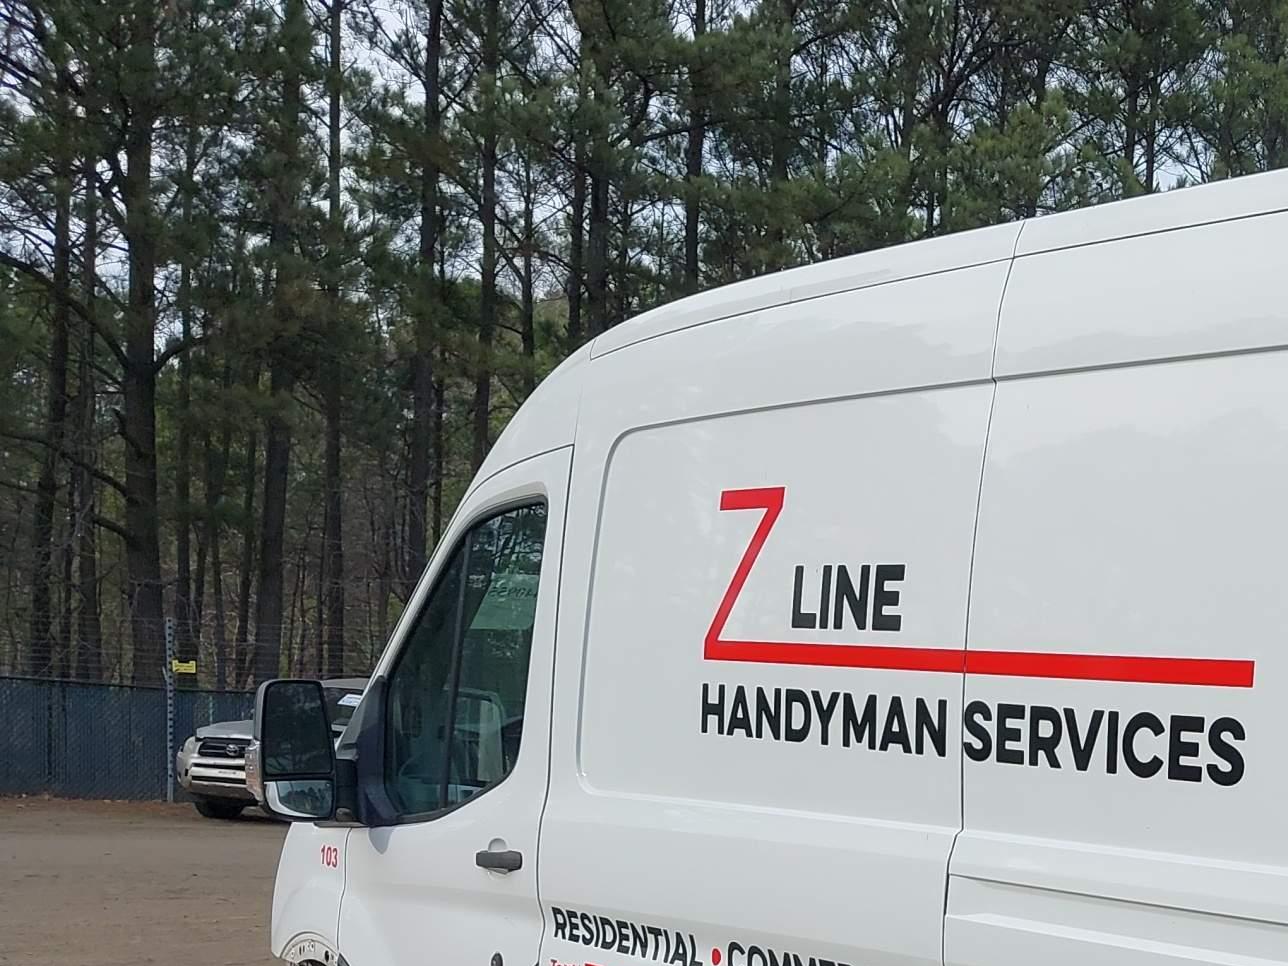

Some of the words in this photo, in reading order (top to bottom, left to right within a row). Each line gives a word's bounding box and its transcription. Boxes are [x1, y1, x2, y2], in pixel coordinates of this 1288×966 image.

[791, 564, 905, 631] LINE
[701, 683, 947, 757] HANDYMAN
[962, 701, 1246, 786] SERVICES
[320, 844, 338, 868] 103
